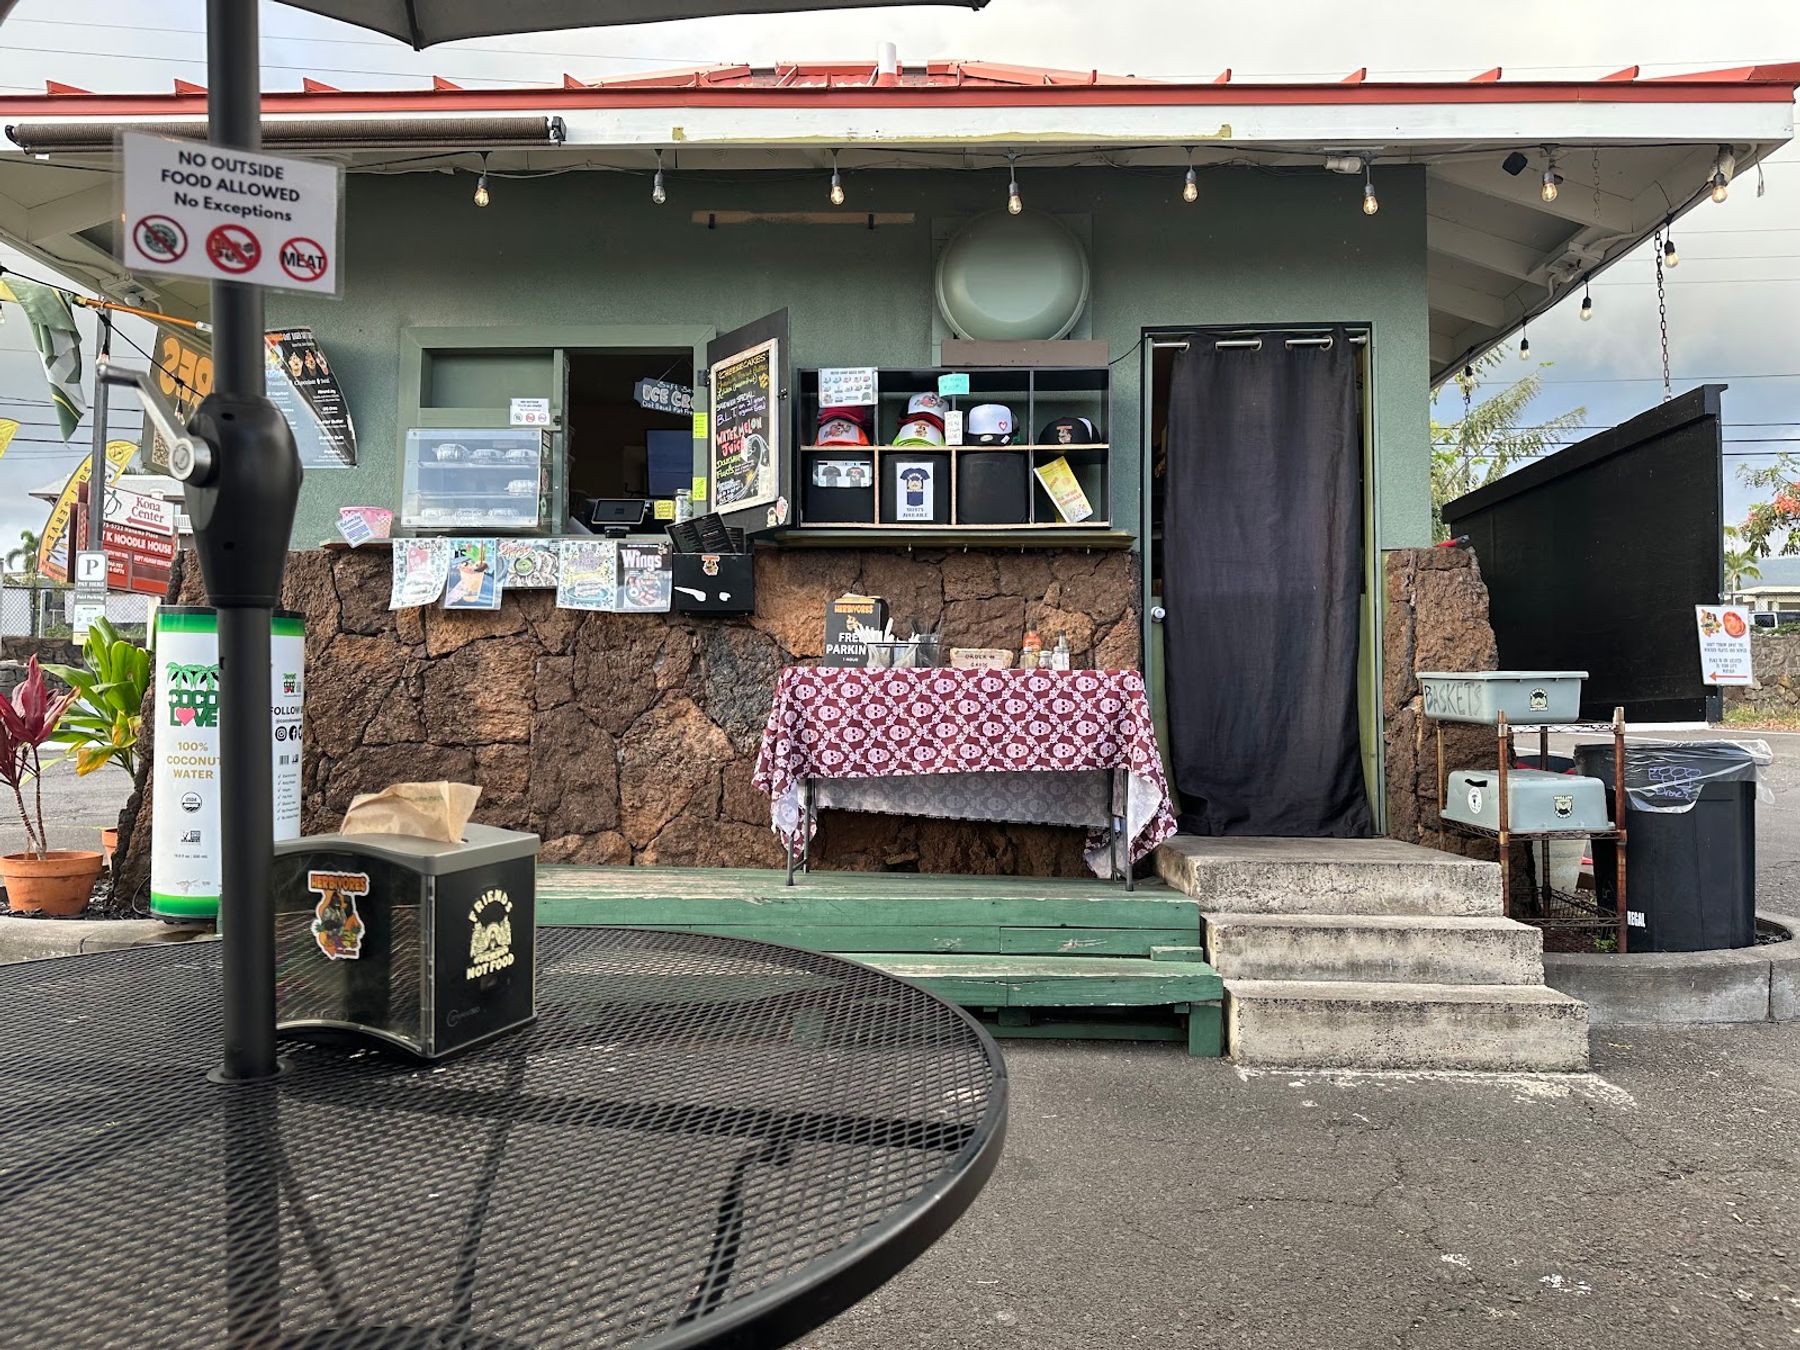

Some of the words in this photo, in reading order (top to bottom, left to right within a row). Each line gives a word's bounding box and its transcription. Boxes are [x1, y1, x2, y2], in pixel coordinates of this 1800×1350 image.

[178, 150, 206, 168] NO
[212, 156, 284, 181] OUTSIDE
[161, 169, 212, 189] FOOD
[216, 177, 300, 202] ALLOWED
[174, 192, 199, 208] No
[203, 196, 293, 222] Exceptions
[281, 250, 325, 271] MEAT
[642, 384, 669, 404] ICE
[131, 506, 165, 522] Center
[136, 496, 161, 512] Kona
[114, 533, 146, 549] NOODLE
[147, 540, 172, 555] HOUSE
[86, 559, 99, 575] P
[620, 549, 662, 571] Wings
[825, 644, 866, 655] PARKIN
[168, 689, 220, 709] COCO
[1424, 681, 1482, 717] BASKETS
[177, 742, 209, 751] 100%
[173, 769, 214, 779] WATER
[311, 874, 367, 893] HERBIVORES
[468, 889, 513, 923] FRIENDS
[466, 962, 489, 980] NOT
[489, 953, 515, 973] FOOD
